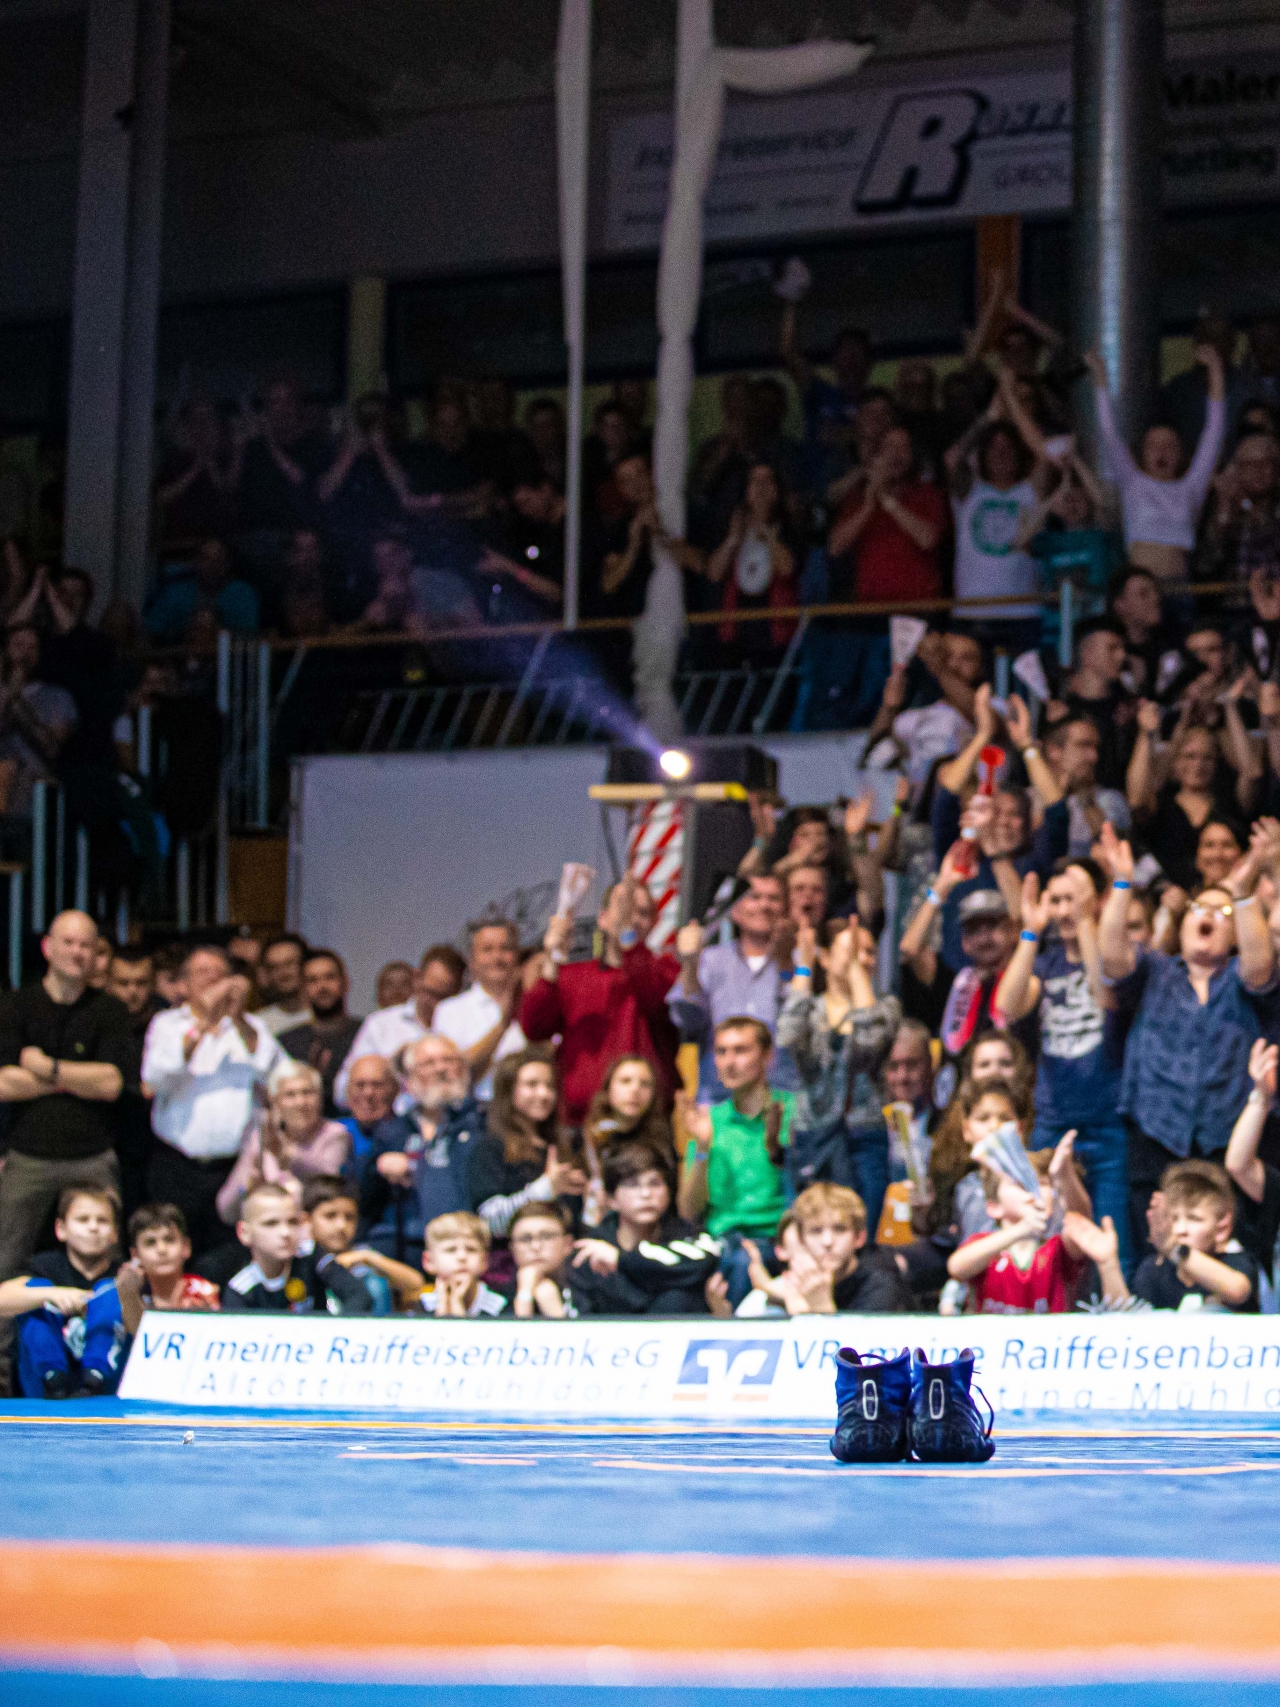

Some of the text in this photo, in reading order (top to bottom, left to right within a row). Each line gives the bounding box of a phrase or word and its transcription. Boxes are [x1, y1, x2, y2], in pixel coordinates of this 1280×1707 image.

[143, 1332, 662, 1369] VR meine Raiffeisenbank eG
[866, 1337, 985, 1370] mine
